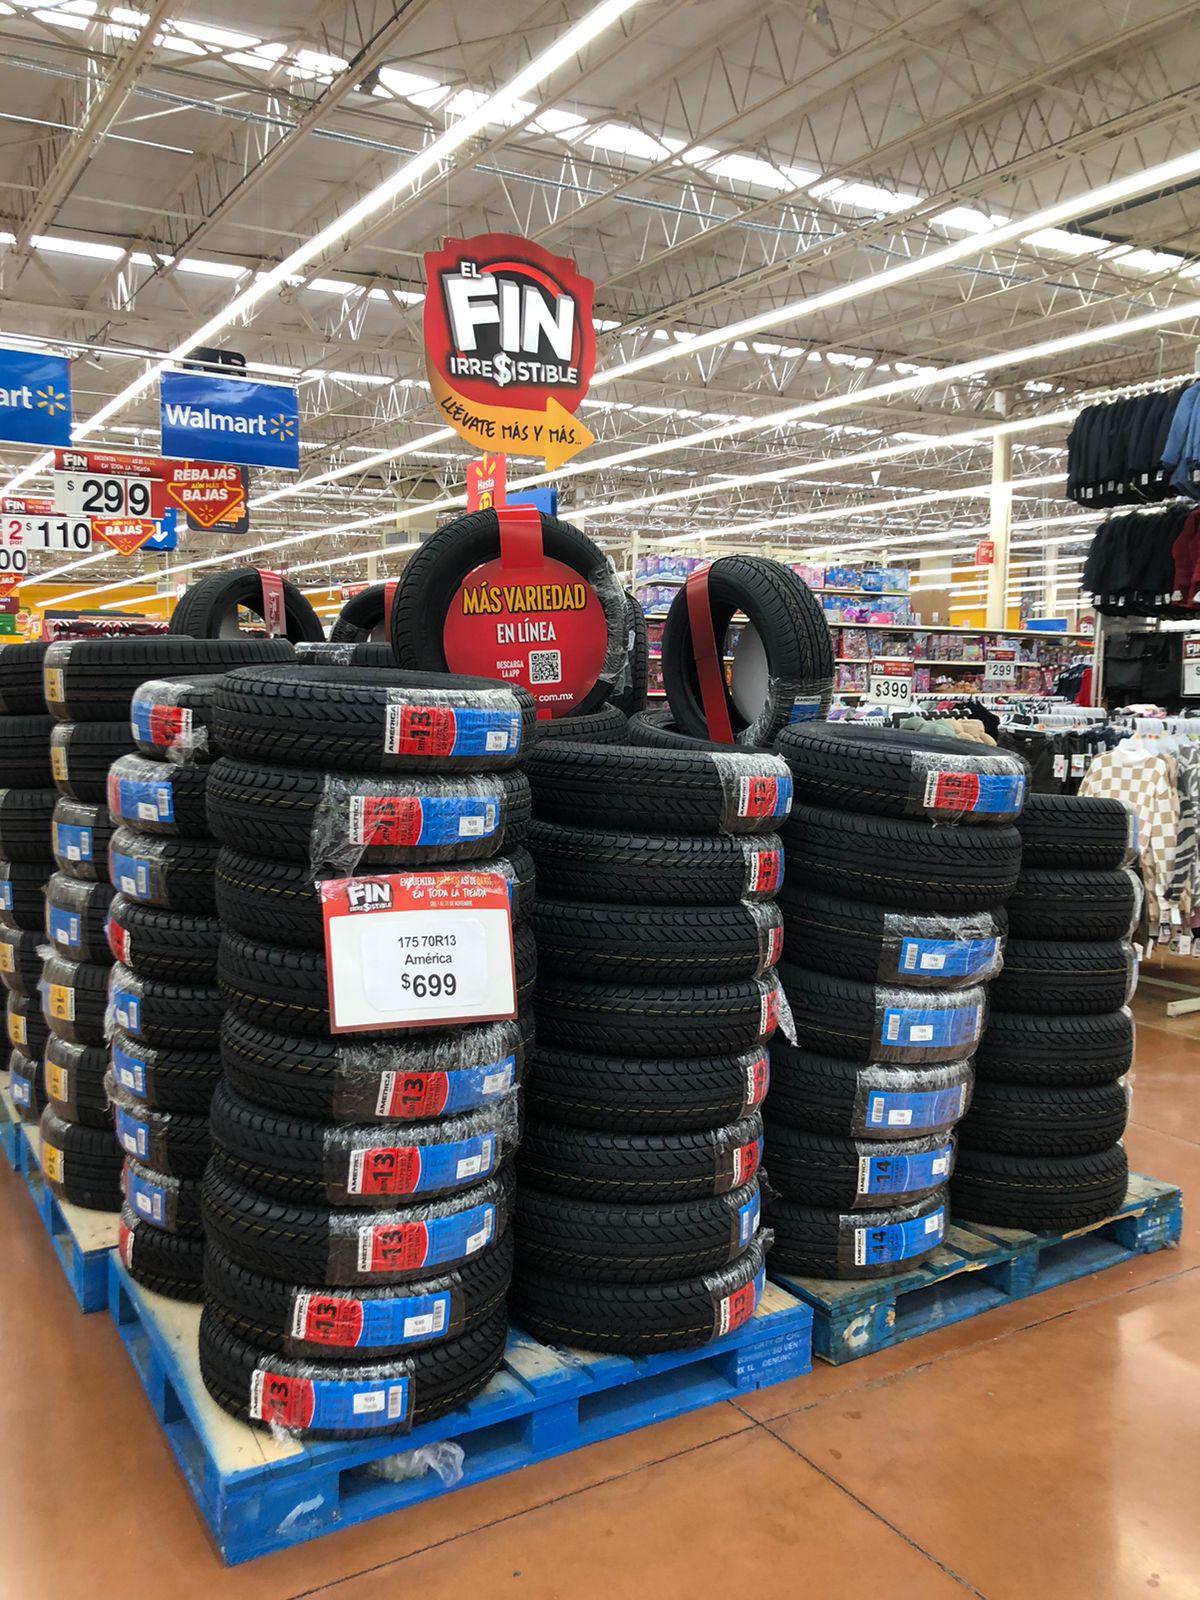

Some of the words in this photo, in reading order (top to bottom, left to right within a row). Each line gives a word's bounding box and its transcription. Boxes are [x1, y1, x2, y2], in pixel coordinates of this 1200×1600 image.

[460, 261, 482, 278] EL
[442, 272, 575, 362] FIN
[450, 350, 578, 387] IRRE$ISTIBLE
[165, 403, 267, 436] Walmart
[440, 396, 495, 438] LLÉVATE
[502, 421, 529, 441] MÁS
[534, 425, 543, 442] Y
[62, 454, 87, 467] FIN
[173, 468, 237, 481] REBAJAS
[477, 478, 495, 490] Hasta
[183, 488, 229, 501] BAJAS
[9, 520, 22, 540] 2
[105, 525, 143, 536] BAJAS
[462, 581, 502, 615] MÁS
[501, 584, 587, 614] VARIEDAD
[497, 623, 515, 644] EN
[518, 618, 556, 642] LÍNEA
[496, 660, 525, 670] DESCARGA
[502, 670, 508, 678] LA
[509, 669, 520, 677] APP
[875, 681, 908, 699] $399
[388, 705, 396, 752] AMERICA
[410, 711, 430, 738] 13
[417, 737, 425, 751] RIN
[754, 782, 766, 804] 13
[926, 772, 935, 806] AMERICA
[374, 802, 395, 827] 13
[347, 882, 391, 907] FIN
[412, 888, 424, 899] EN
[428, 888, 448, 899] TODA
[451, 888, 460, 898] LA
[462, 887, 487, 898] TIENDA
[398, 937, 419, 948] 175
[422, 935, 457, 947] 70R13
[404, 953, 453, 966] América
[401, 973, 457, 998] $699
[379, 1072, 391, 1115] AMERICA
[402, 1078, 424, 1105] 13
[373, 1153, 395, 1182] 13
[876, 1160, 891, 1183] 13
[382, 1230, 403, 1260] 13
[872, 1230, 887, 1253] 13
[316, 1302, 338, 1330] 13
[270, 1381, 288, 1408] 13
